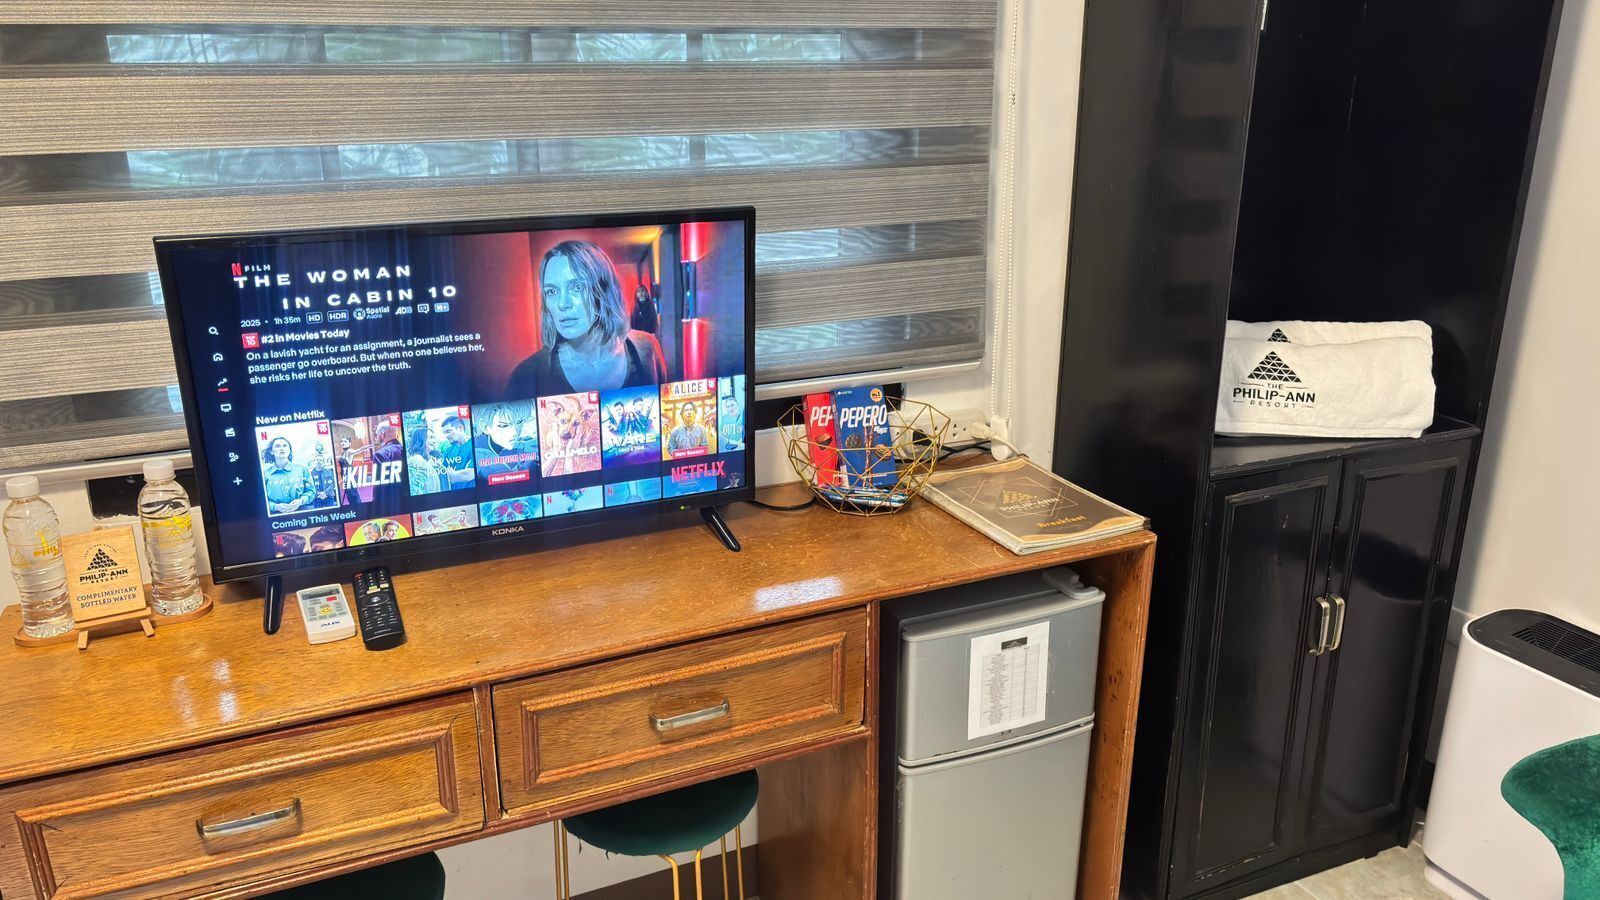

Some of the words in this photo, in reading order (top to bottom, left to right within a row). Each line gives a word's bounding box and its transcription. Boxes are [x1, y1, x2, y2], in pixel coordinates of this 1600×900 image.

[244, 264, 271, 272] FILM
[233, 273, 291, 288] THE
[306, 265, 411, 283] WOMAN
[282, 296, 310, 310] IN
[327, 288, 413, 306] CABIN
[428, 285, 456, 298] 10
[329, 312, 347, 320] HDR
[365, 306, 390, 315] Spatial
[240, 319, 261, 328] 2025
[283, 316, 301, 324] 35m
[261, 334, 275, 344] #2
[285, 331, 319, 342] Movies
[320, 329, 350, 340] Today
[246, 352, 261, 361] On
[270, 348, 297, 358] lavish
[299, 345, 324, 357] yacht
[325, 345, 339, 353] for
[340, 344, 352, 352] an
[353, 339, 406, 351] assignment,
[413, 334, 453, 347] journalist
[248, 361, 296, 374] passenger
[297, 361, 310, 369] go
[311, 354, 359, 366] overboard.
[360, 353, 376, 362] But
[377, 350, 401, 360] when
[402, 350, 414, 358] no
[415, 348, 432, 357] one
[433, 344, 467, 355] believes
[468, 343, 485, 352] her,
[249, 376, 267, 385] she
[268, 373, 290, 383] risks
[292, 371, 307, 380] her
[308, 370, 323, 378] life
[324, 368, 334, 377] to
[335, 365, 370, 375] uncover
[372, 363, 387, 372] the
[387, 361, 411, 370] truth.
[674, 382, 703, 395] ALICE
[1232, 387, 1316, 403] PHILIP-ANN
[1249, 399, 1297, 409] RESORT
[256, 415, 279, 425] New
[280, 414, 293, 422] on
[293, 410, 325, 421] Netflix
[840, 404, 888, 429] PEPERO
[347, 460, 403, 490] KILLER
[671, 461, 726, 483] NETFLIX
[272, 518, 307, 530] Coming
[309, 516, 329, 524] This
[331, 511, 357, 521] Week
[1036, 515, 1087, 528] Breakfast
[491, 525, 525, 536] KONKA
[79, 568, 129, 582] PHILIP-ANN
[76, 585, 138, 602] COMPLIMENTARY
[80, 598, 112, 609] BOTTLED
[112, 593, 137, 603] WATER
